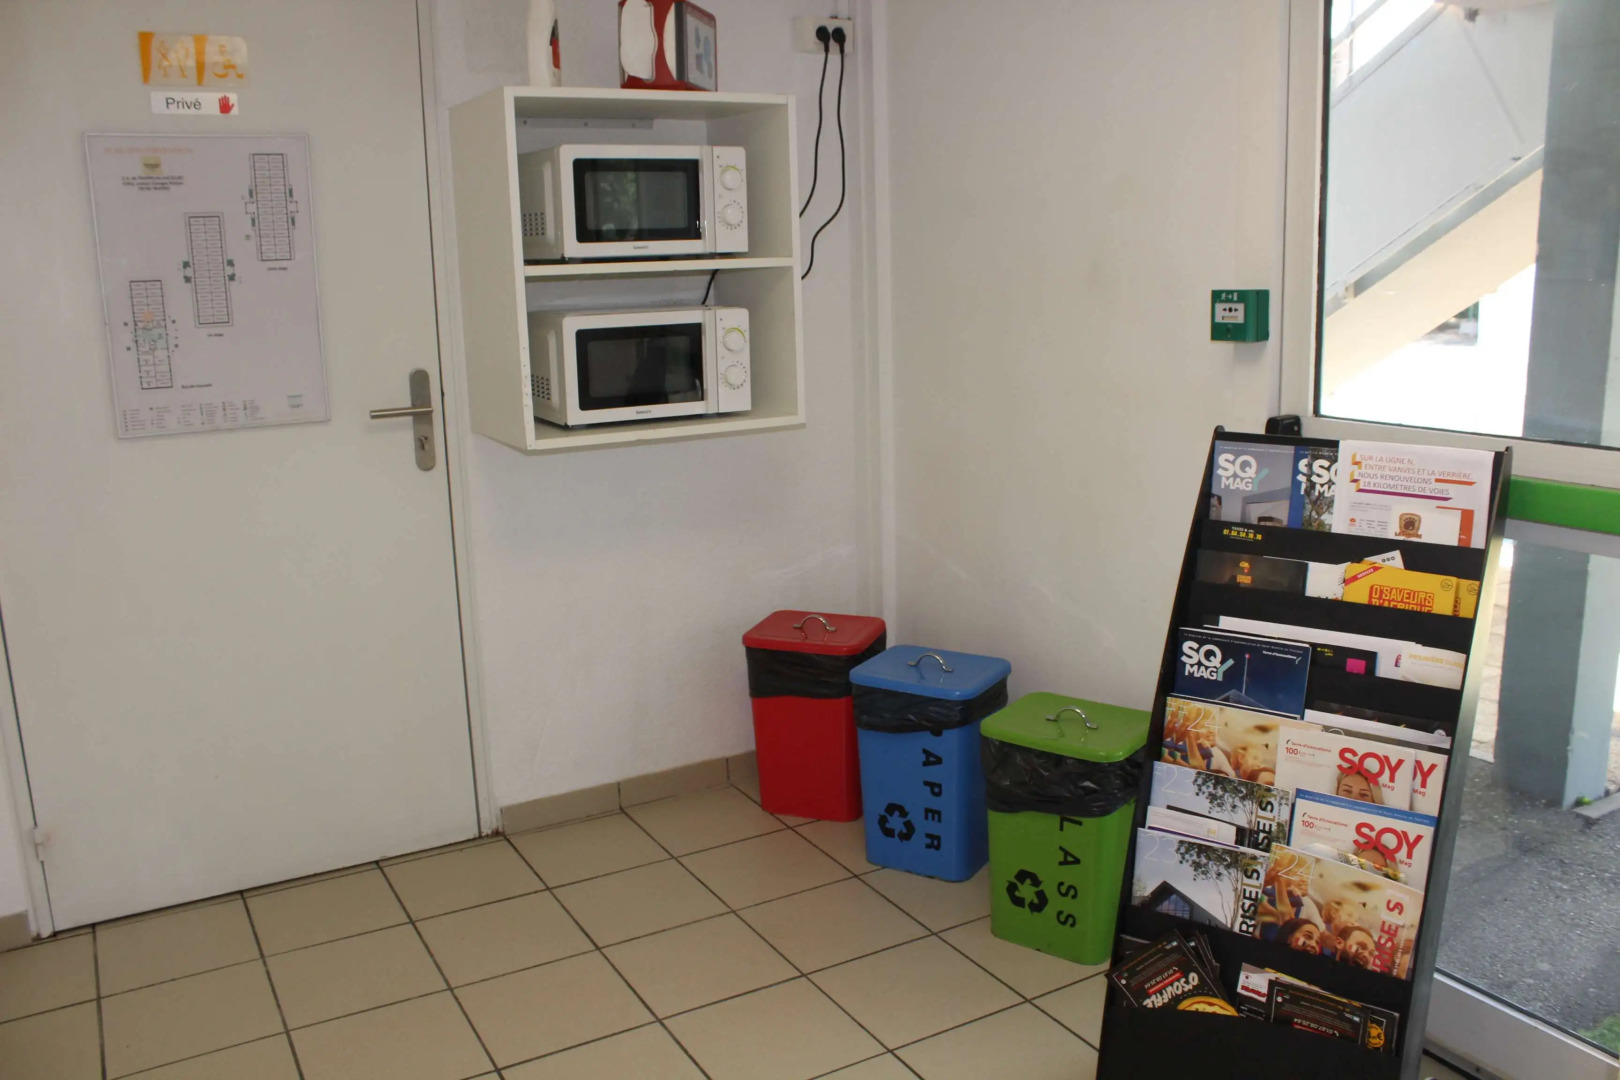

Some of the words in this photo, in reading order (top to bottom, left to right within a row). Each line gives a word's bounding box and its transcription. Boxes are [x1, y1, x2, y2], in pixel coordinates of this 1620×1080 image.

[165, 96, 202, 111] Privé
[1358, 472, 1379, 481] NOUS
[1380, 474, 1433, 485] RENOUVELONS
[1417, 468, 1426, 476] ET
[1427, 469, 1436, 477] LA
[1221, 477, 1252, 491] MAG
[1362, 480, 1371, 488] 18
[1417, 486, 1428, 494] DE
[1429, 487, 1450, 496] VOIES
[1184, 664, 1218, 680] MAG
[1056, 815, 1084, 928] LASS
